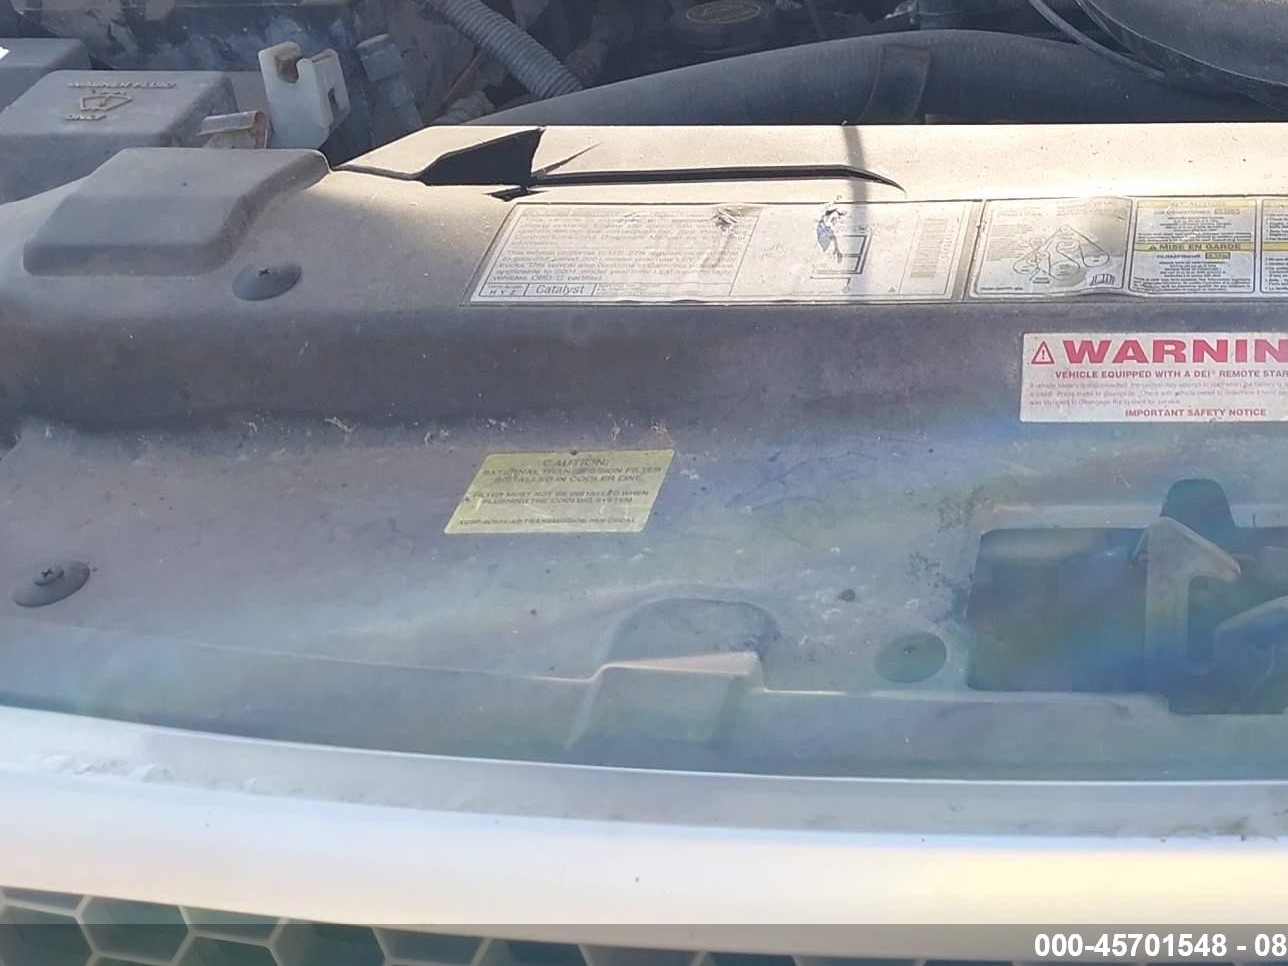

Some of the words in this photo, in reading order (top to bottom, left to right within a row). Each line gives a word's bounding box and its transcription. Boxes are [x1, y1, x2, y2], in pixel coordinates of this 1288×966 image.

[535, 284, 585, 296] Catalyst
[1055, 370, 1098, 379] VEHICLE
[1101, 370, 1151, 379] EQUIPPED
[1155, 370, 1180, 379] WITH
[1184, 370, 1191, 379] A
[1219, 370, 1260, 378] REMOTE
[1125, 409, 1184, 418] IMPORTANT
[1187, 409, 1226, 417] SAFETY
[1228, 409, 1266, 417] NOTICE
